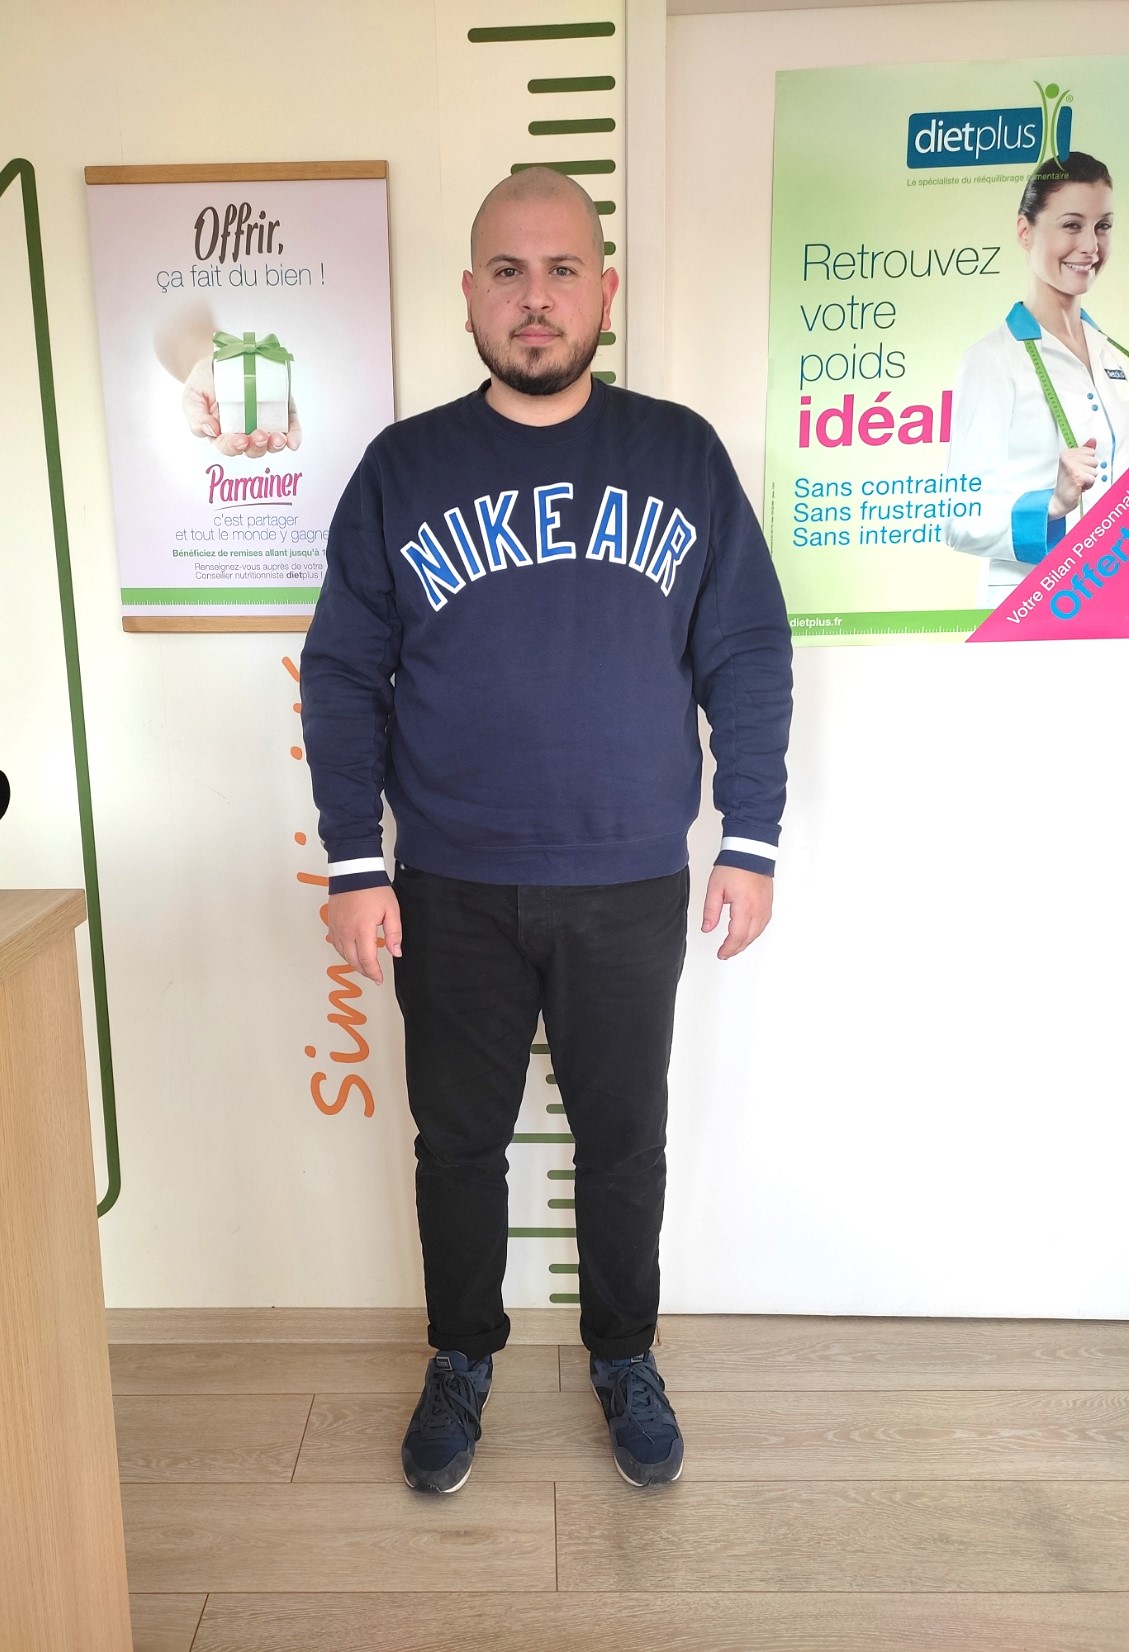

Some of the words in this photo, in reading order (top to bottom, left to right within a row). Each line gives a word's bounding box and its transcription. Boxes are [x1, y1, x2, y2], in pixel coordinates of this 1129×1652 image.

[914, 115, 1036, 160] dietplus
[906, 178, 916, 187] Le
[918, 176, 960, 187] spécialiste
[961, 176, 972, 185] du
[973, 174, 1024, 184] rééquilibrage
[194, 202, 284, 264] Offrir,
[803, 243, 1001, 282] Retrouvez
[156, 270, 184, 293] ça
[190, 264, 222, 288] fait
[229, 264, 258, 286] du
[265, 264, 312, 287] bien
[320, 263, 325, 285] !
[800, 295, 897, 332] votre
[800, 342, 906, 391] poids
[798, 390, 953, 449] idéal
[205, 463, 303, 503] Parrainer
[794, 477, 852, 498] Sans
[861, 474, 983, 496] contrainte
[213, 514, 243, 526] c'est
[247, 514, 299, 529] partager
[793, 502, 851, 523] Sans
[860, 498, 982, 520] frustration
[175, 530, 187, 541] et
[191, 529, 215, 540] tout
[218, 529, 229, 540] le
[232, 529, 277, 540] monde
[280, 531, 287, 543] y
[400, 482, 577, 612] NIKE
[585, 485, 697, 597] AIR
[792, 527, 850, 547] Sans
[859, 524, 941, 545] interdit
[172, 549, 216, 557] Bénéficiez
[217, 549, 228, 557] de
[230, 549, 263, 557] remises
[265, 549, 288, 557] allant
[289, 549, 320, 558] jusqu'à
[1006, 590, 1044, 625] Votre
[1040, 556, 1076, 592] Bilan
[1072, 489, 1129, 558] Personna
[194, 563, 261, 572] Renseignez-vous
[262, 563, 291, 572] auprès
[292, 563, 302, 571] de
[303, 563, 324, 571] votre
[195, 572, 233, 580] Conseiller
[234, 572, 284, 580] nutritionniste
[286, 571, 319, 581] dietplus
[790, 616, 843, 629] dietplus.fr
